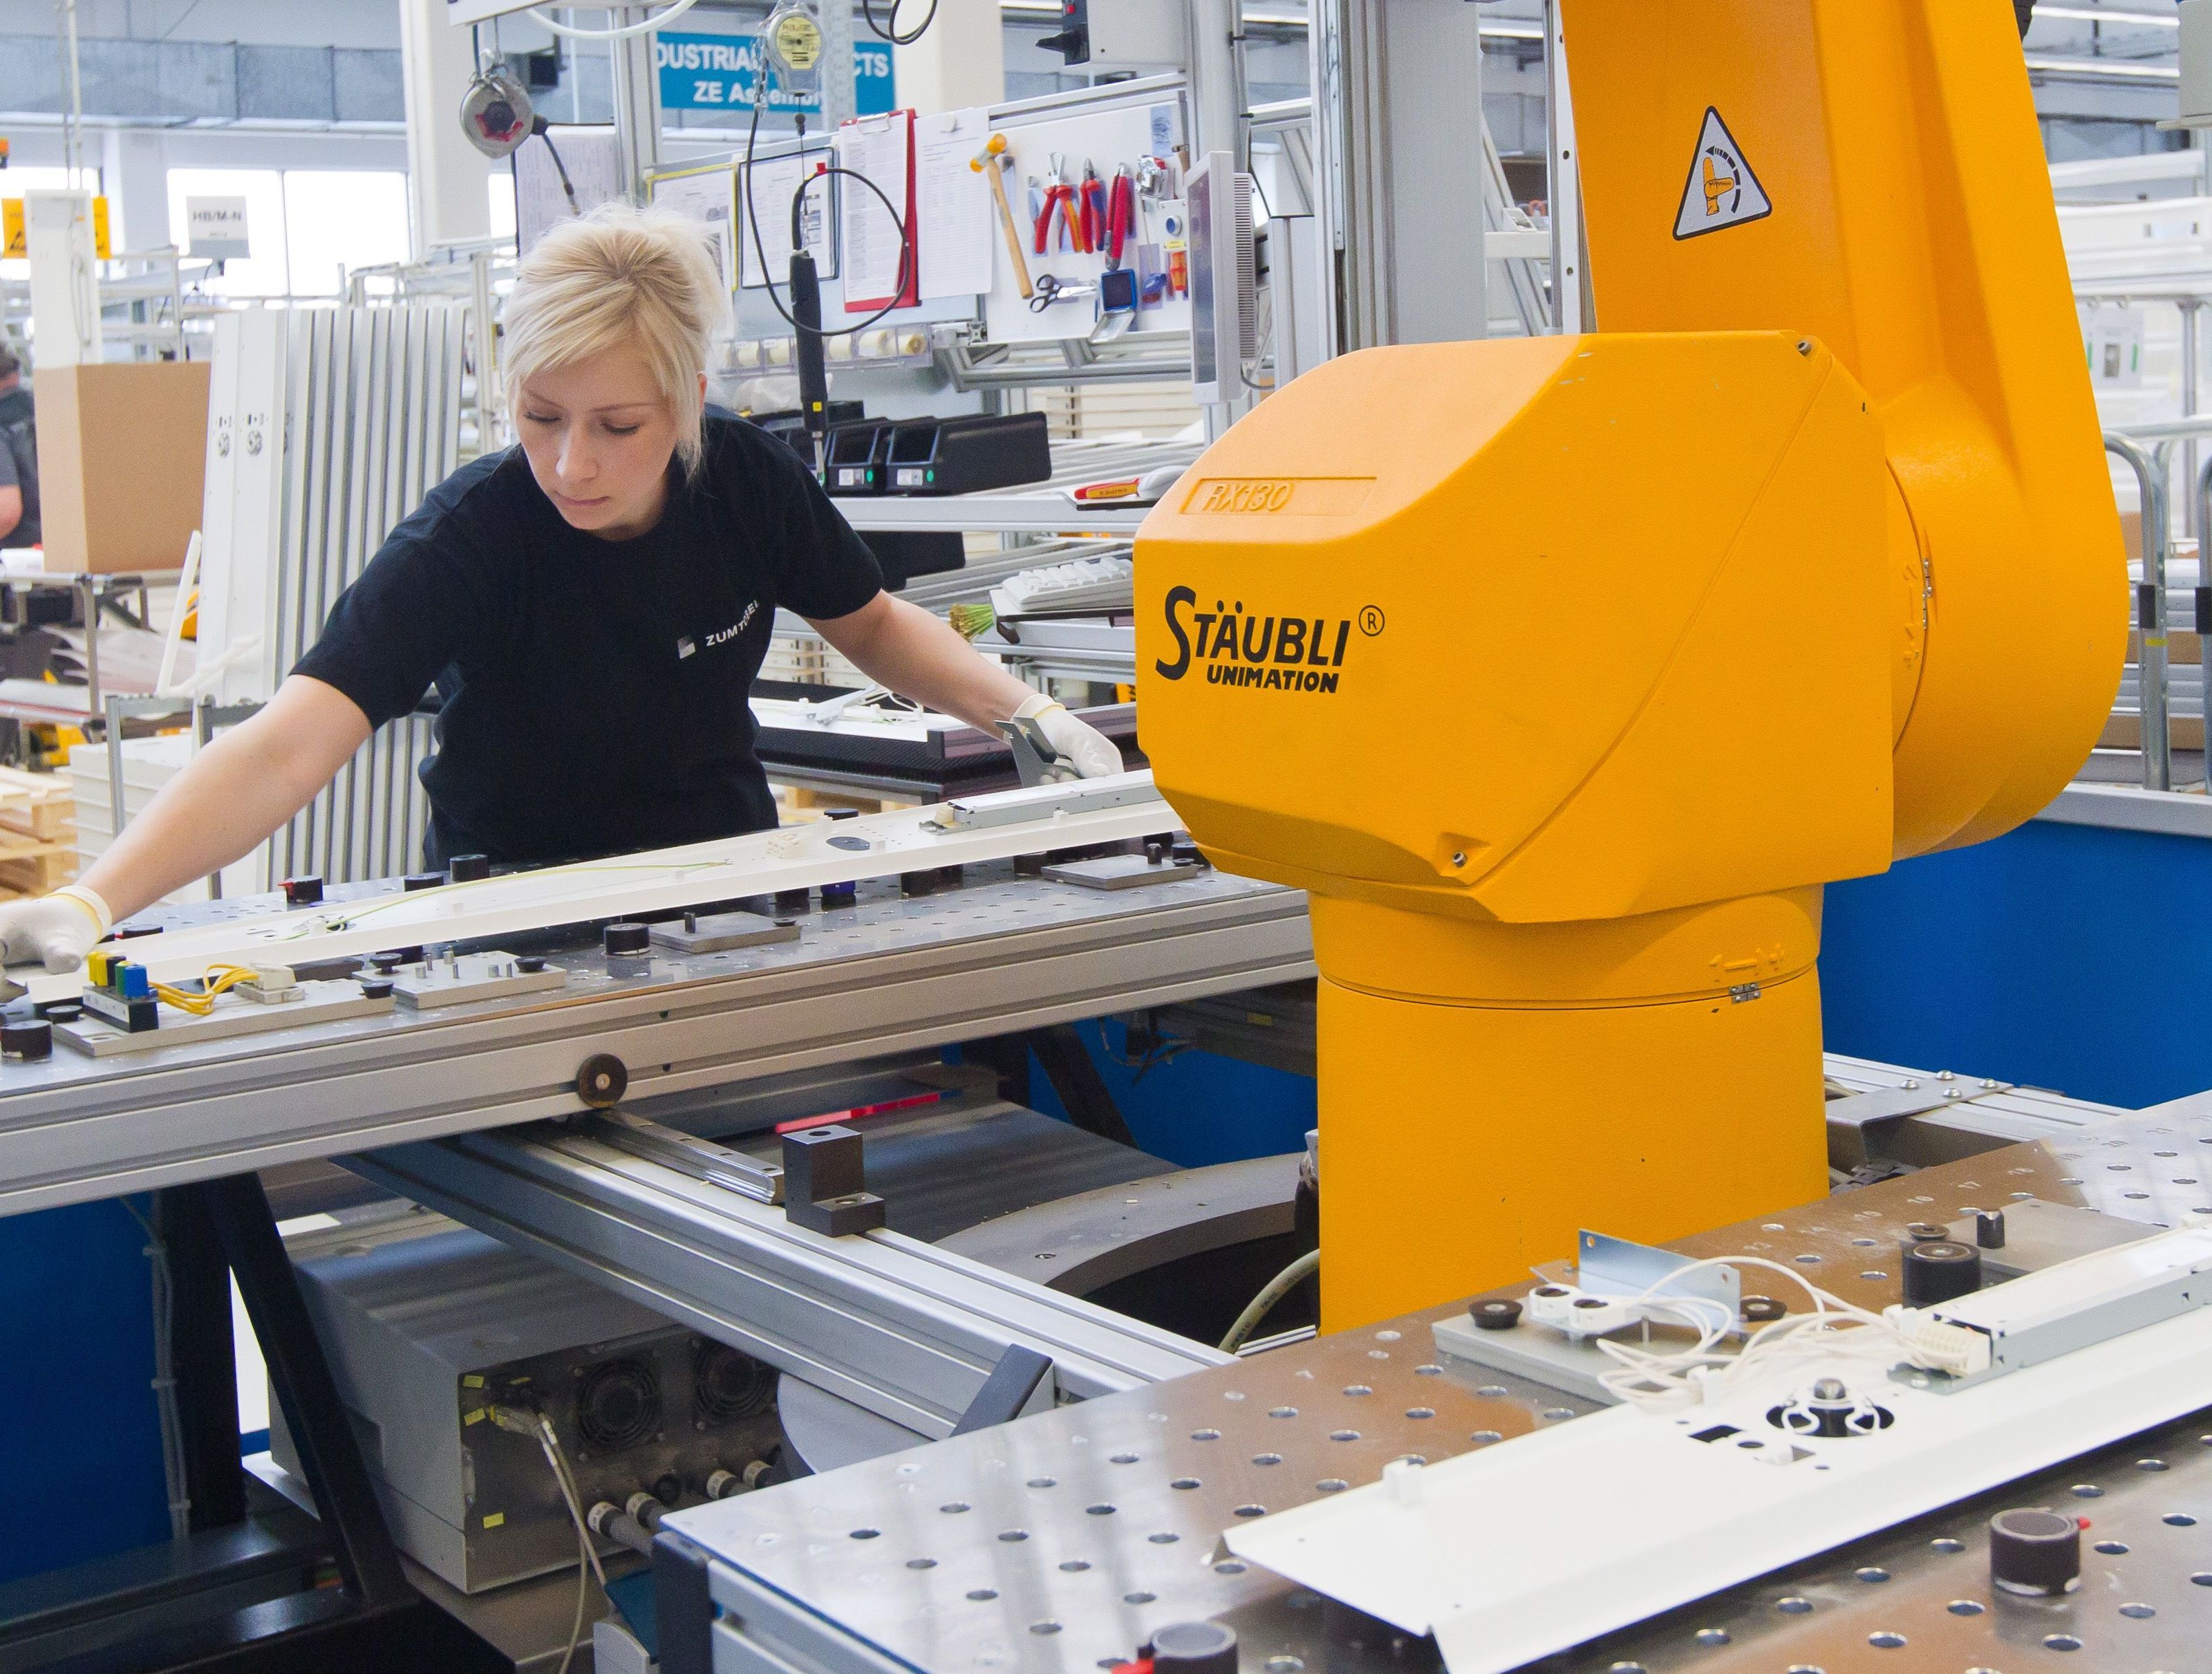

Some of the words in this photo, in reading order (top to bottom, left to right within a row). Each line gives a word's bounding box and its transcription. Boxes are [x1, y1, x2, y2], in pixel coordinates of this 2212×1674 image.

[693, 80, 724, 103] ZE
[1201, 483, 1295, 513] RX130
[1155, 585, 1351, 681] STÄUBLI
[1207, 664, 1339, 694] UNIMATION
